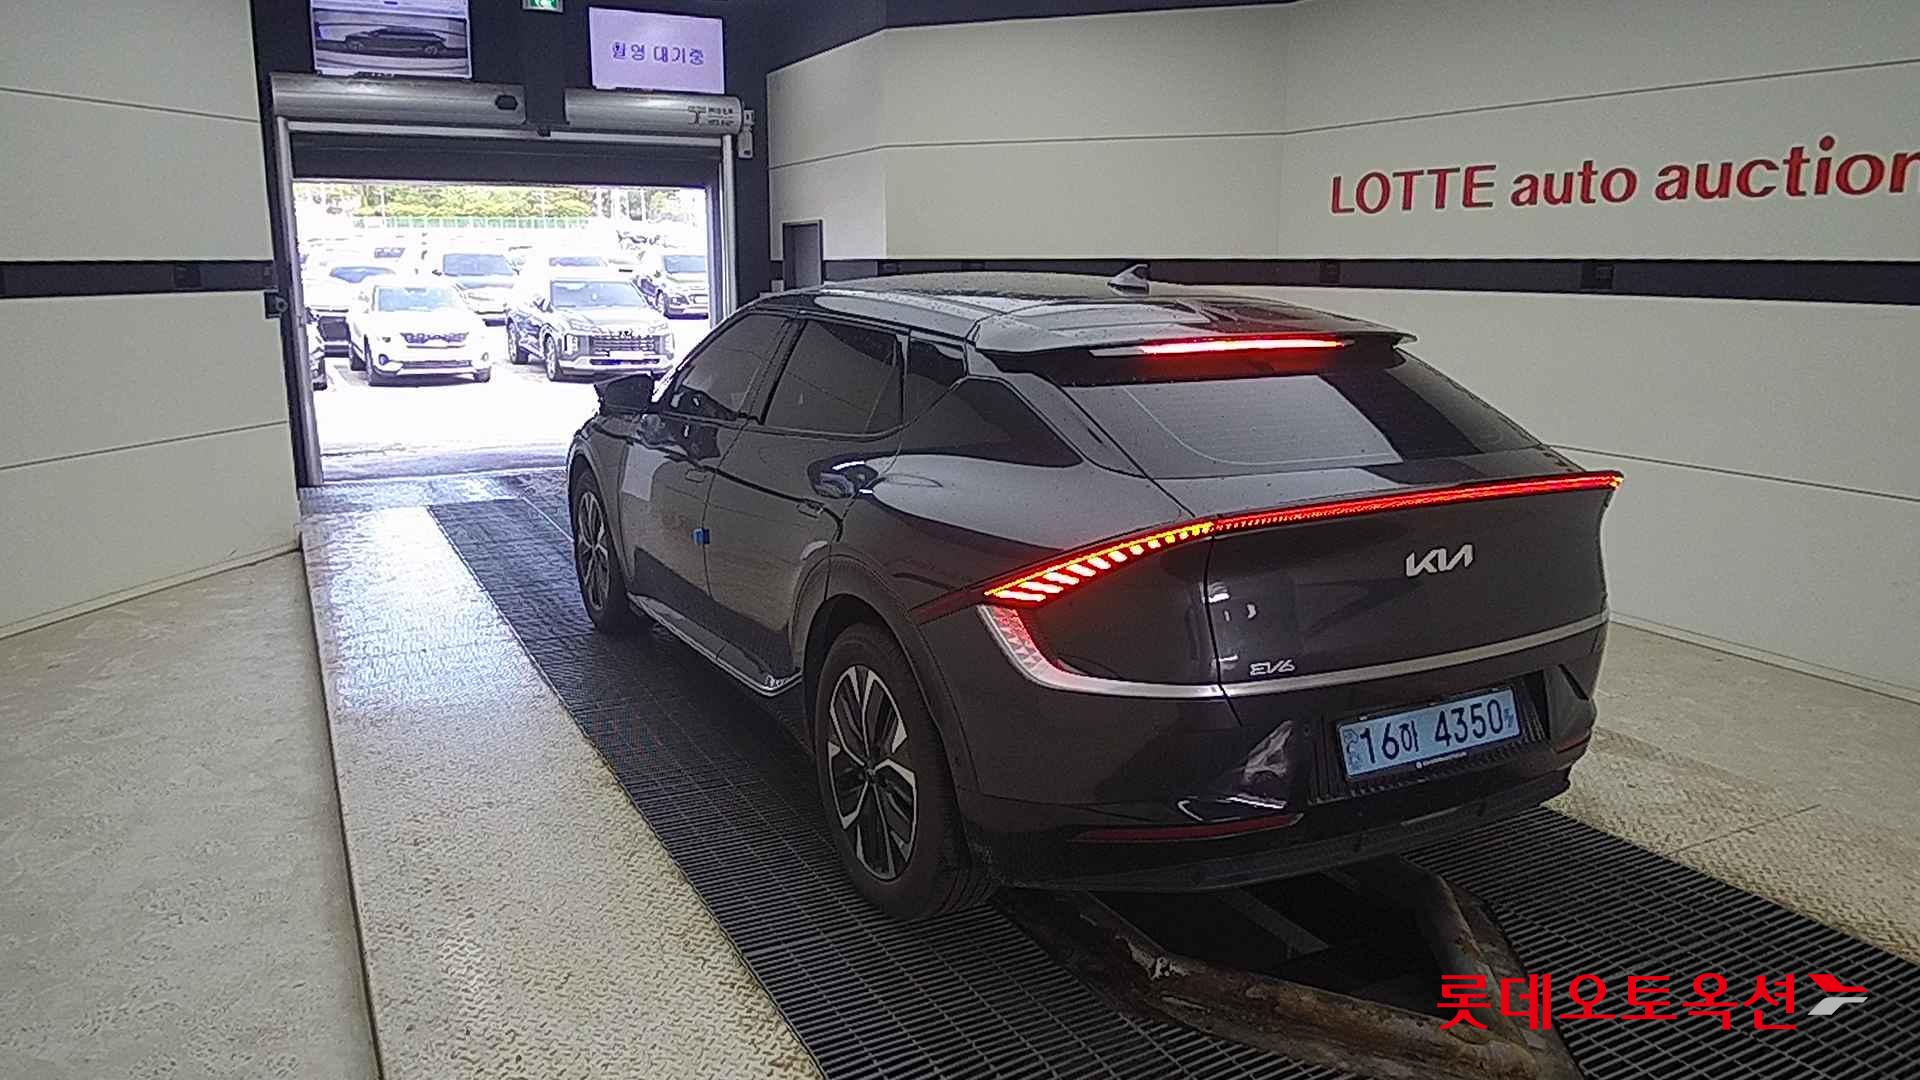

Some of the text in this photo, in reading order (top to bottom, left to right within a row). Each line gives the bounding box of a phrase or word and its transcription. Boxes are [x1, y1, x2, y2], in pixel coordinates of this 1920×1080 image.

[653, 45, 705, 66] 대기중
[1330, 164, 1497, 214] LOTTE
[1511, 159, 1638, 206] auto
[1405, 544, 1474, 577] KIA
[1249, 659, 1296, 676] EV6
[1434, 699, 1504, 748] 4350
